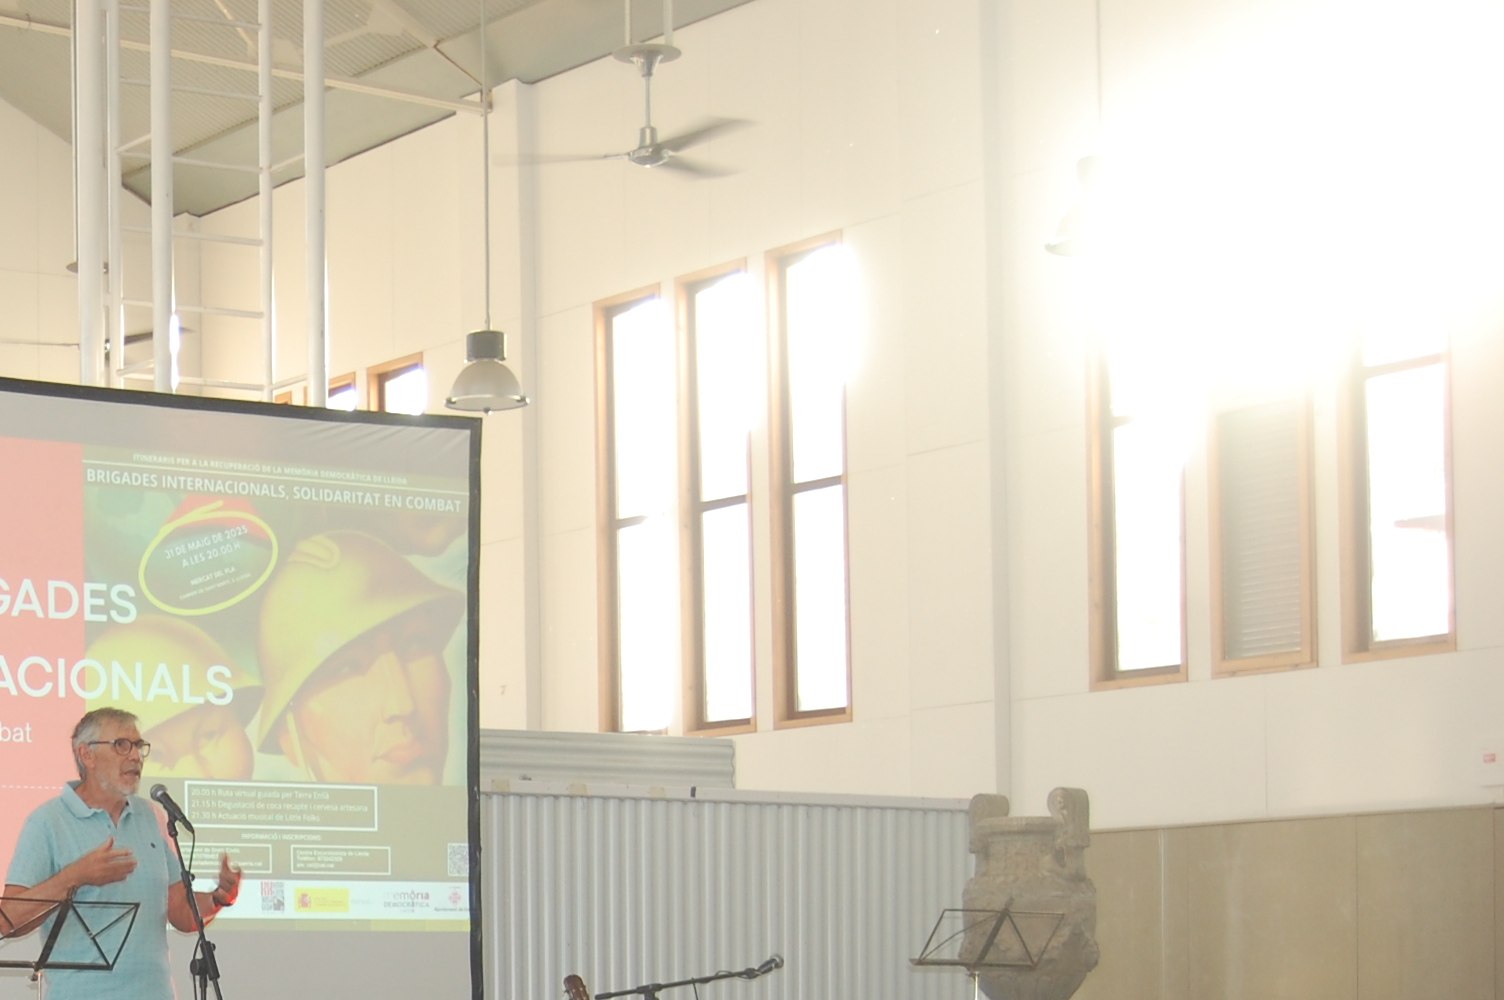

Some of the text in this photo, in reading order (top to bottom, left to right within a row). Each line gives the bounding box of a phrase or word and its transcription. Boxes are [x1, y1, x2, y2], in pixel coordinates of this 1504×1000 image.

[132, 453, 175, 465] ITINERARIS
[176, 457, 190, 466] PER
[199, 459, 208, 468] LA
[210, 459, 260, 472] RECUPERACIÓ
[262, 465, 271, 473] DE
[272, 466, 282, 474] LA
[373, 475, 382, 483] DE
[383, 475, 408, 485] LLEIDA
[86, 468, 462, 513] BRIGADES INTERNACIONALS, SOLIDARITAT EN COMBAT
[164, 524, 248, 560] 31 DE MAIG DE 2025
[182, 541, 241, 568] A LES 20.00 H
[191, 788, 210, 796] 20.00
[218, 788, 234, 797] Ruta
[234, 789, 256, 798] virtual
[258, 790, 280, 800] guiada
[281, 792, 292, 800] per
[294, 791, 312, 799] Terra
[191, 800, 210, 808] 21.15
[218, 800, 255, 811] Degustació
[256, 802, 265, 810] de
[282, 803, 309, 812] recapte
[313, 804, 338, 812] cervesa
[339, 804, 368, 812] artesana
[191, 812, 210, 820] 21.30
[218, 812, 247, 820] Actuació
[248, 813, 274, 821] musical
[275, 813, 284, 821] de
